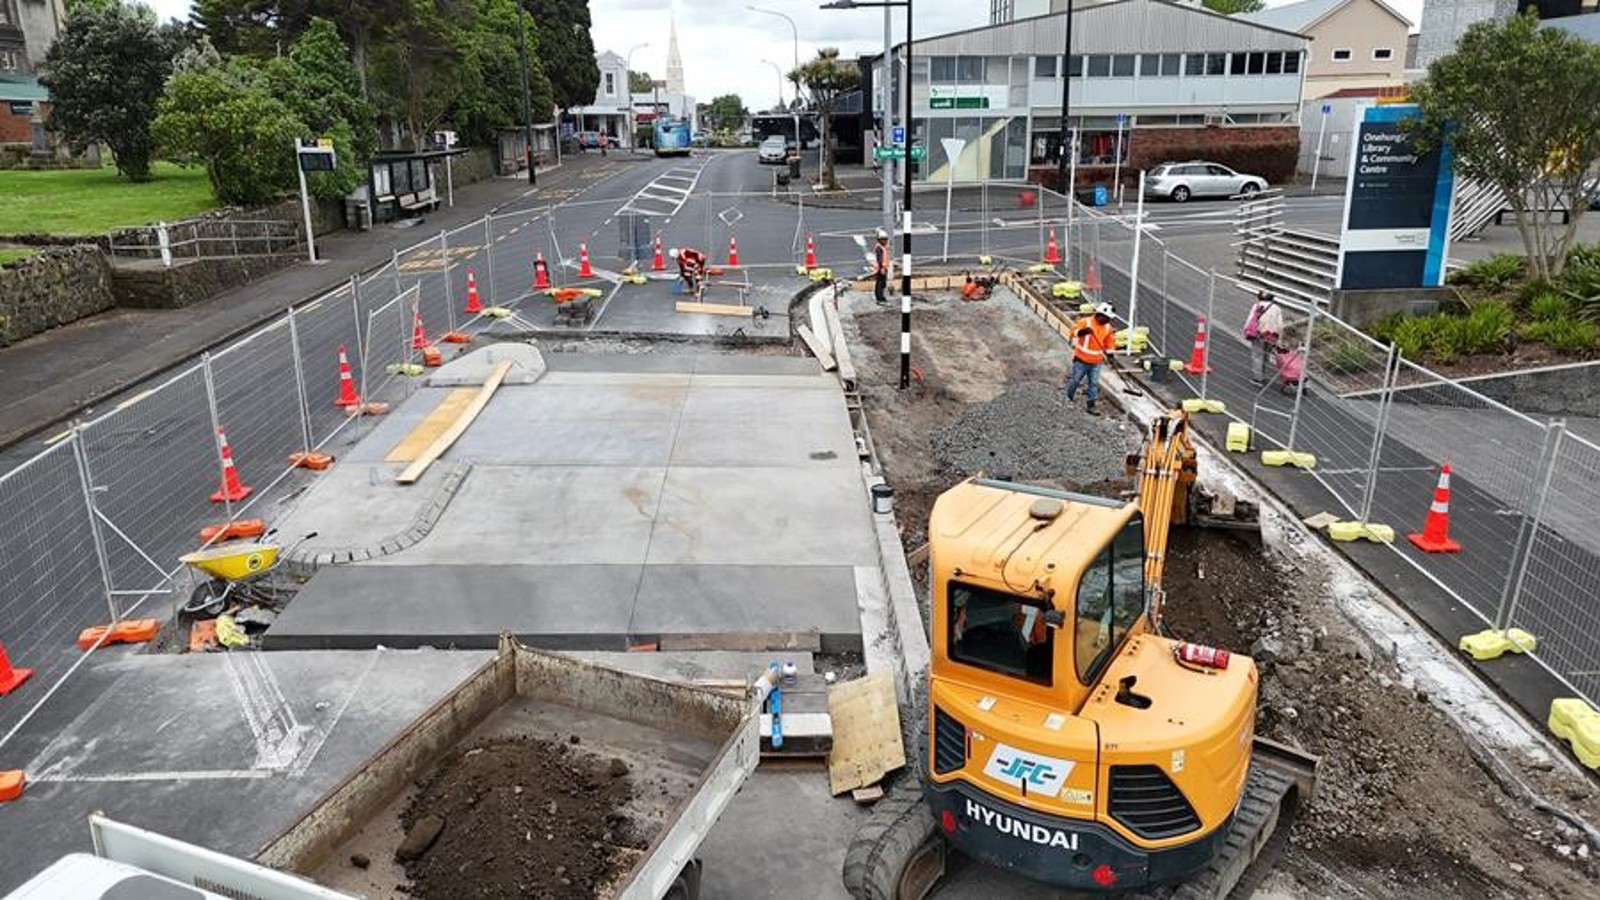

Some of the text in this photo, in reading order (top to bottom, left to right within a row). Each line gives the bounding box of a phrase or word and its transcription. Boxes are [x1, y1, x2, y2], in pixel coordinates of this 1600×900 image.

[1362, 144, 1391, 155] Library
[1361, 154, 1418, 165] & Community
[1360, 165, 1388, 174] Centre
[966, 798, 1079, 851] HYUNDAI
